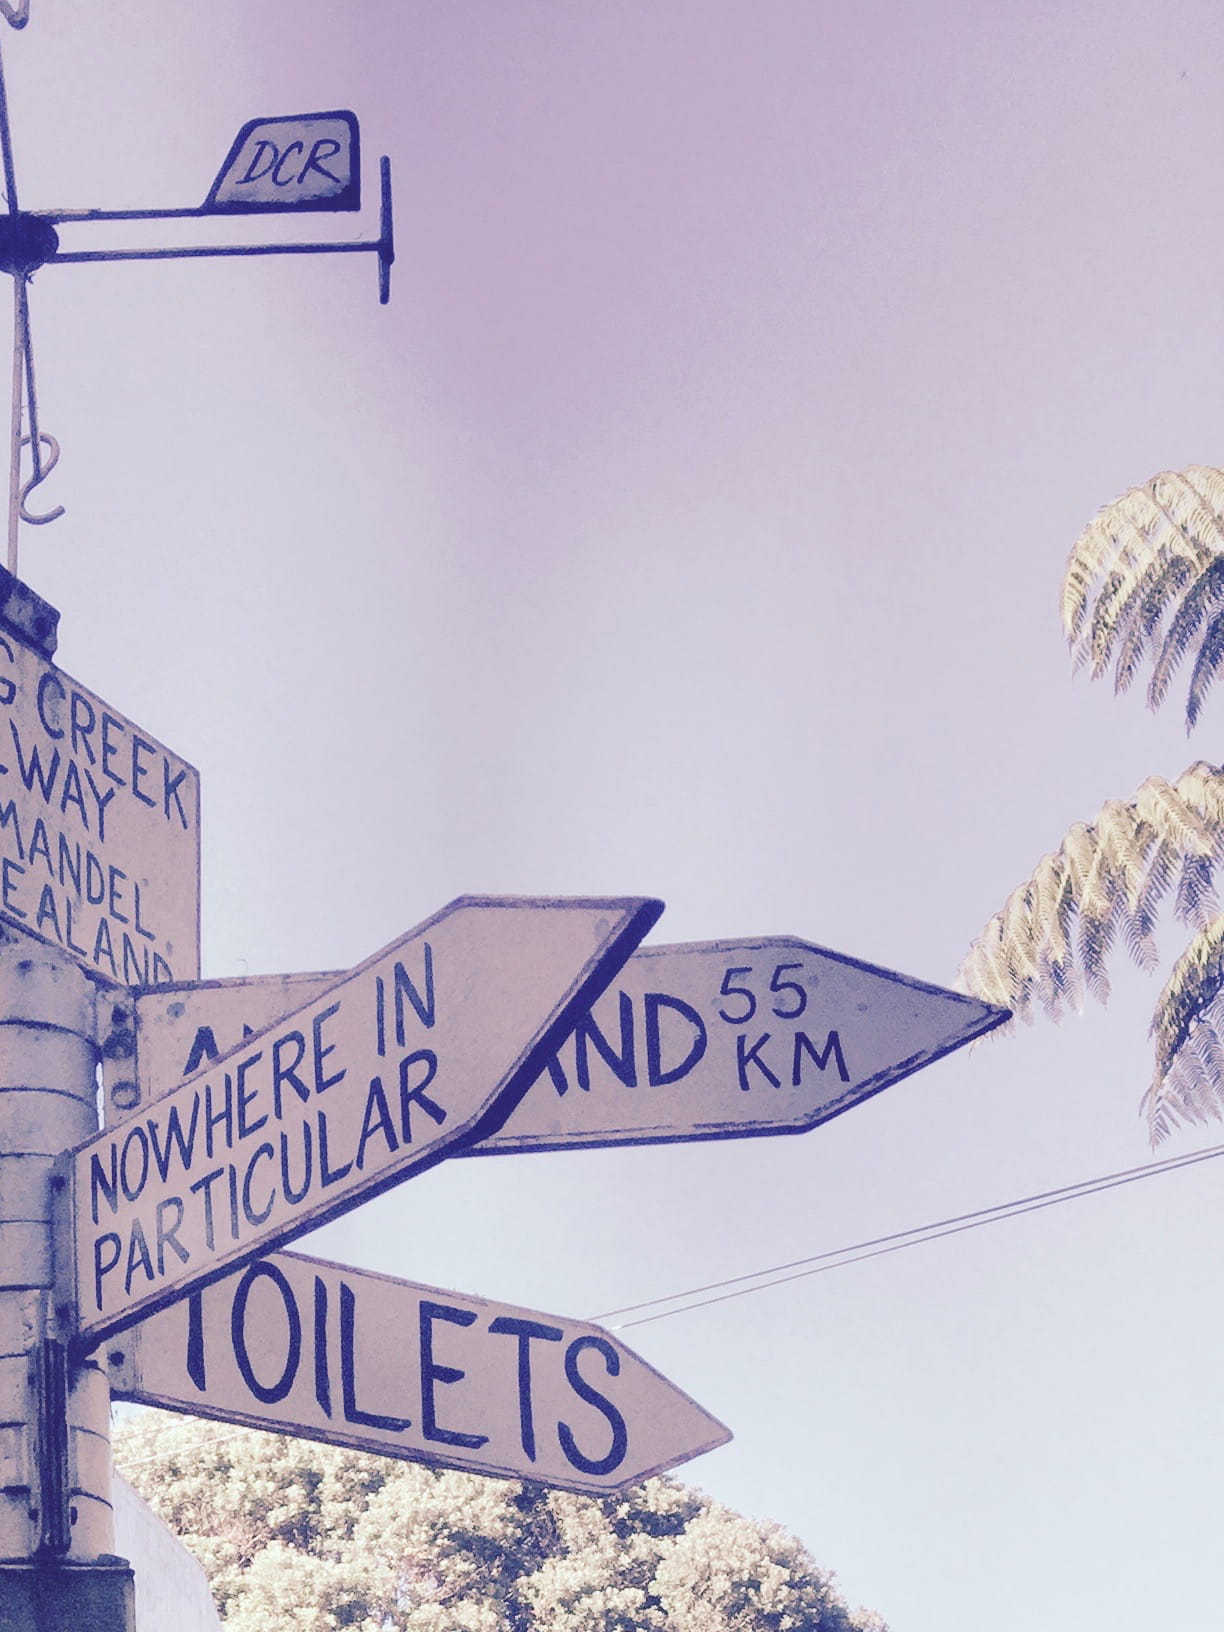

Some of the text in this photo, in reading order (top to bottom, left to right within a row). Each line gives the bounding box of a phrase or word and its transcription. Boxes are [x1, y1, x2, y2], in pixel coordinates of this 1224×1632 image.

[235, 139, 342, 186] DCR
[37, 671, 188, 829] CREEK
[719, 963, 807, 1025] 55
[89, 1003, 348, 1225] NOWHERE
[376, 941, 438, 1059] IN
[737, 1030, 851, 1092] KM
[94, 1048, 448, 1310] PARTICULAR
